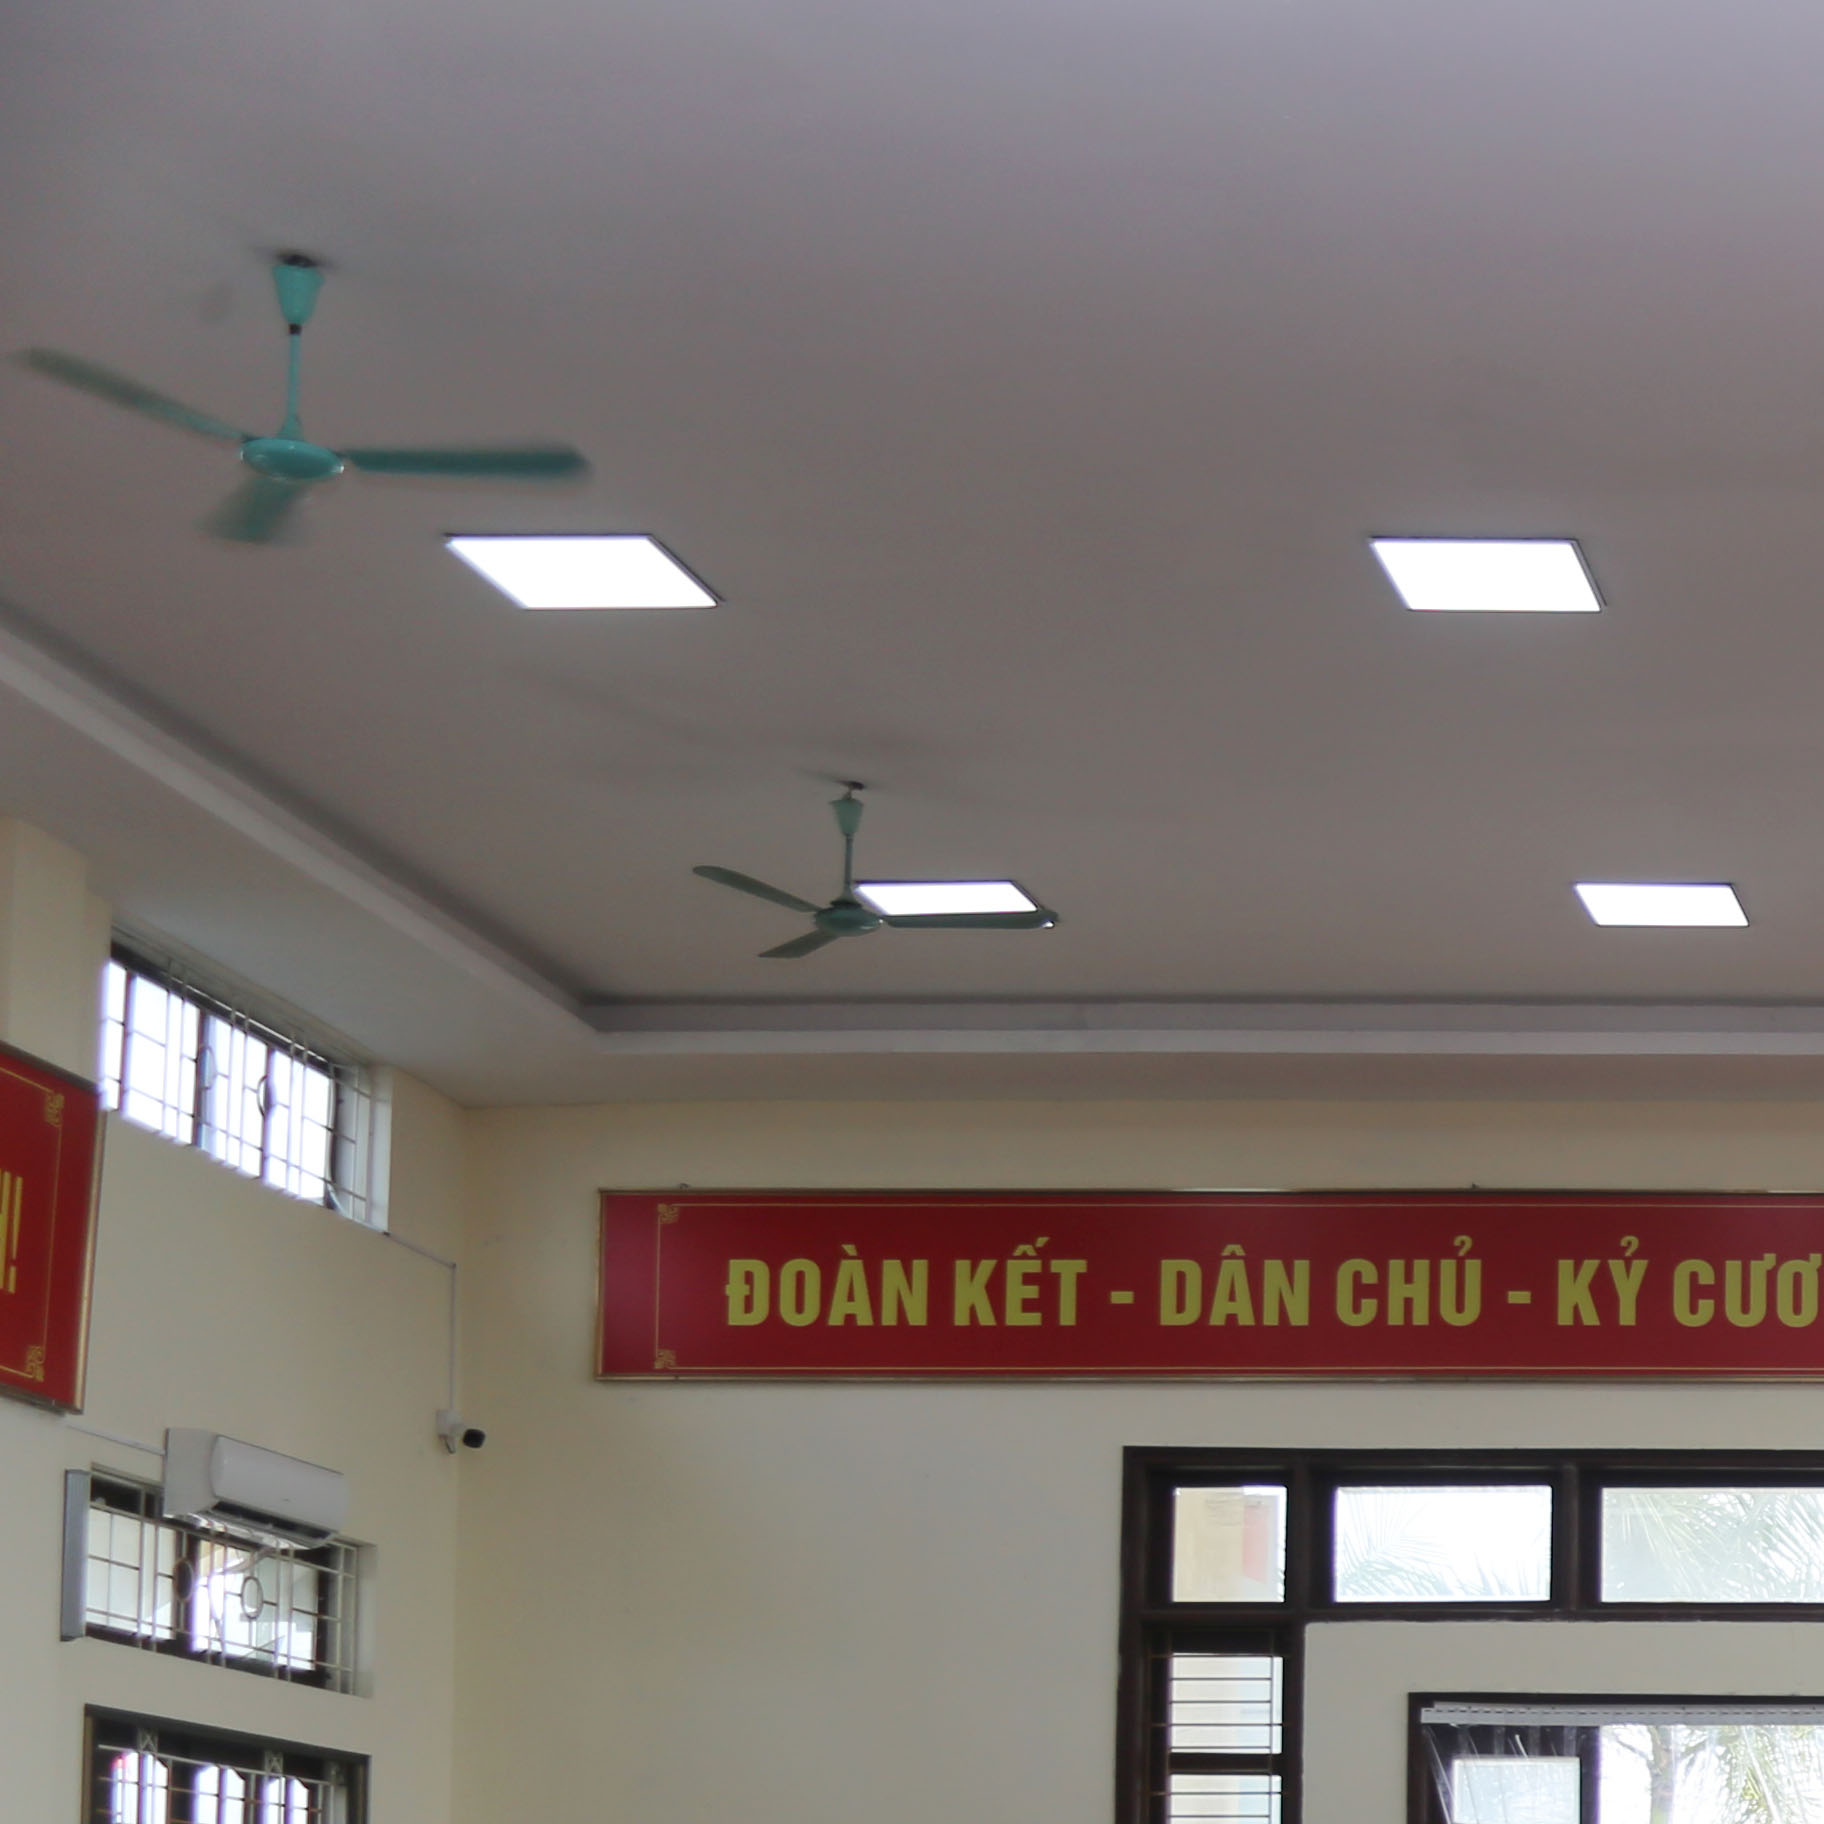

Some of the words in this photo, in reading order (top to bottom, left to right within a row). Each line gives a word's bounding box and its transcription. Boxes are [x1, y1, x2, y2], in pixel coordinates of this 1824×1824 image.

[725, 1243, 929, 1327] ĐOÀN
[954, 1236, 1088, 1327] KẾT
[1160, 1244, 1310, 1327] DÂN
[1336, 1235, 1482, 1327] CHỦ
[1557, 1235, 1650, 1327] KỶ
